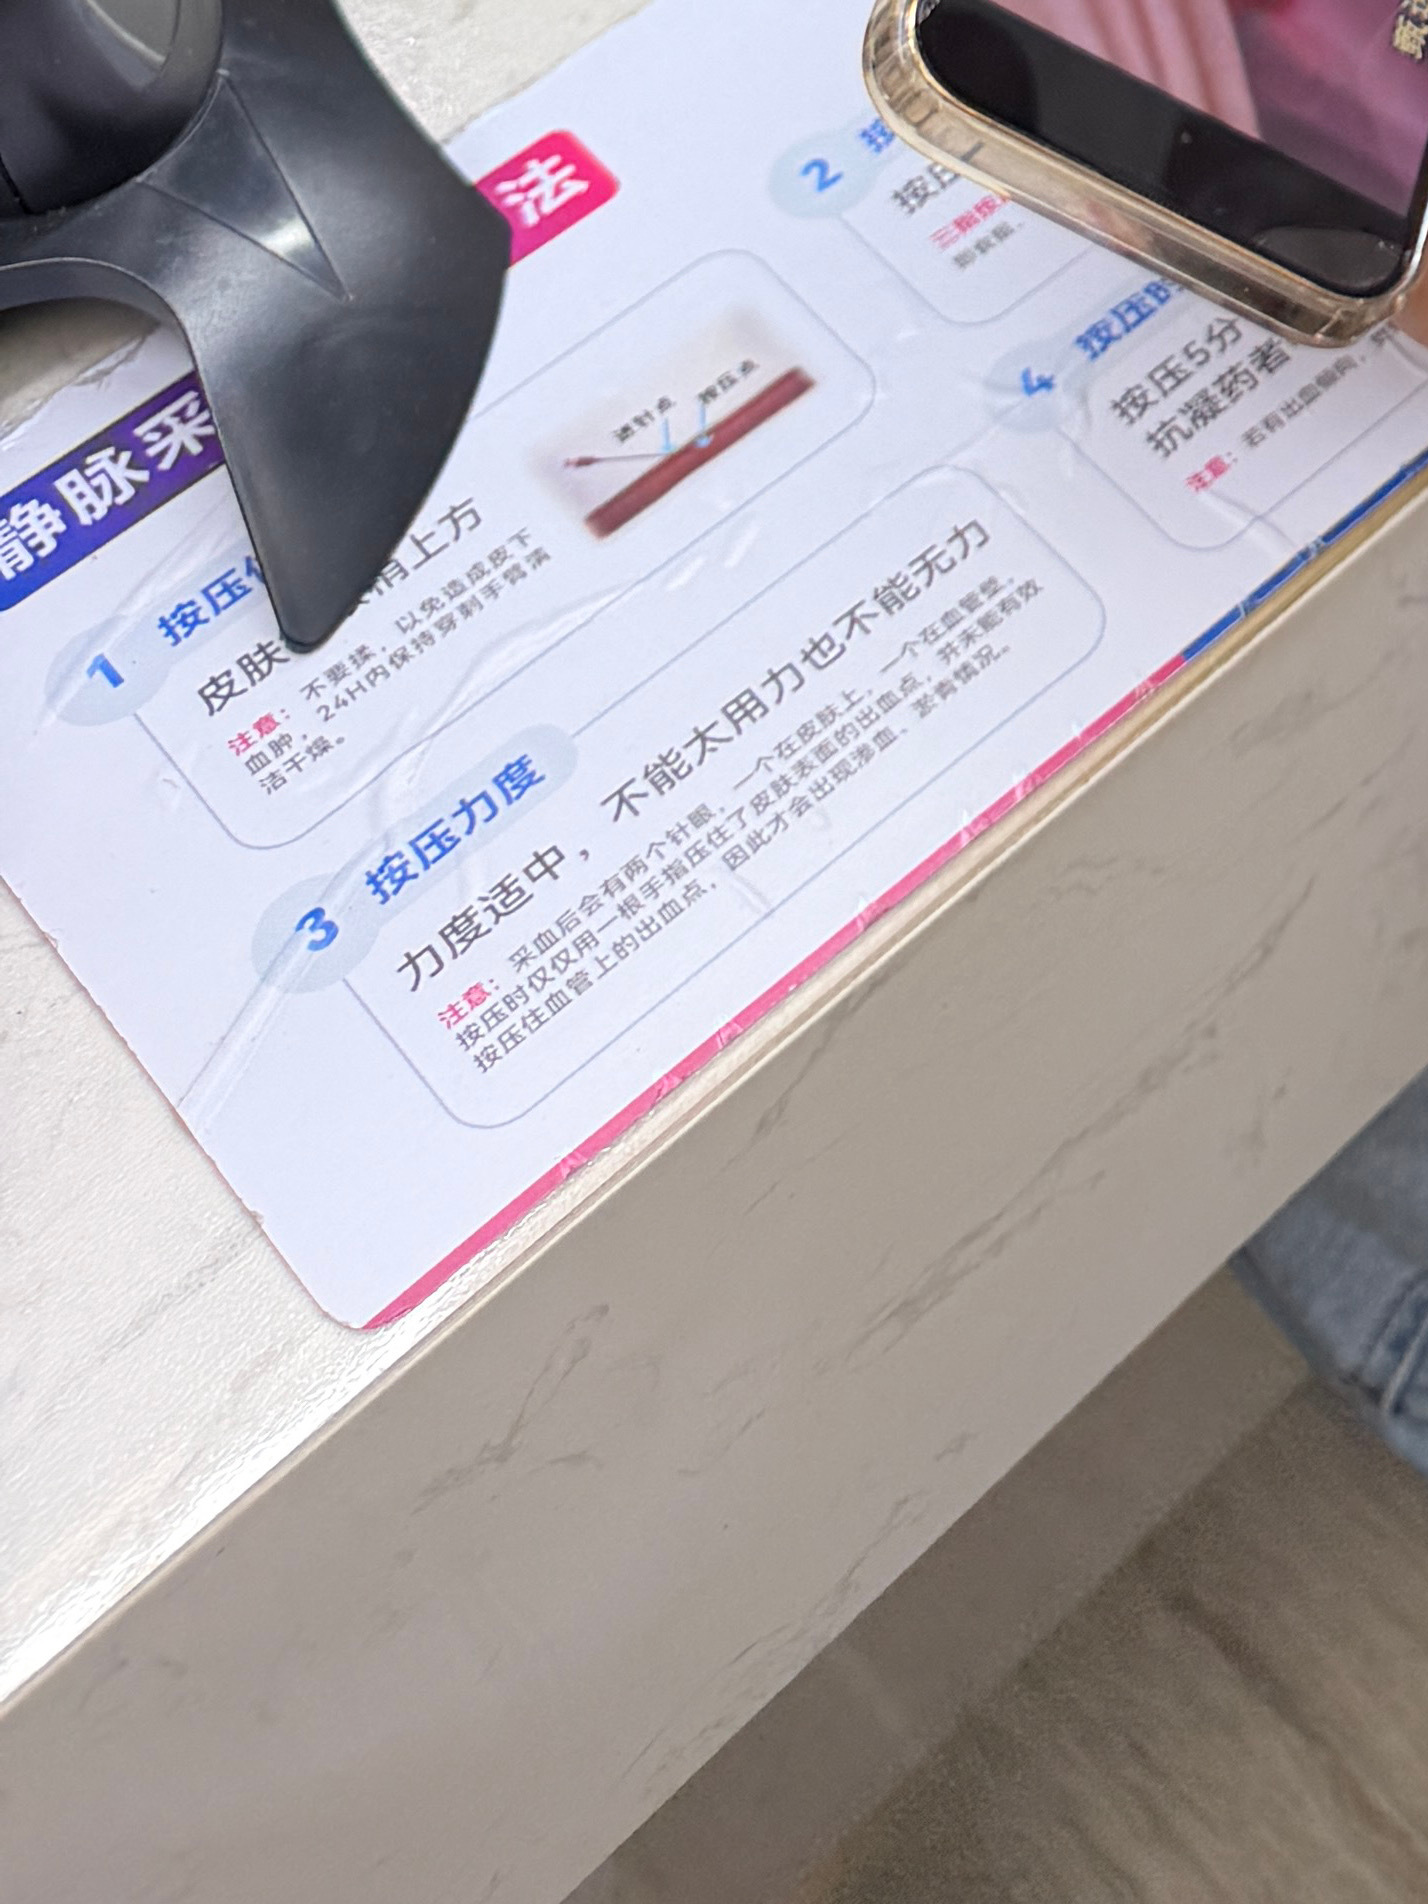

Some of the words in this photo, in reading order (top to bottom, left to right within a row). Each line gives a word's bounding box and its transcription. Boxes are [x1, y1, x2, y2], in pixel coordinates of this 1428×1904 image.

[495, 157, 591, 225] 法
[797, 155, 843, 194] 2
[1019, 365, 1055, 399] 4
[86, 653, 126, 690] 1
[294, 906, 341, 951] 3
[366, 755, 545, 905] 按压力度
